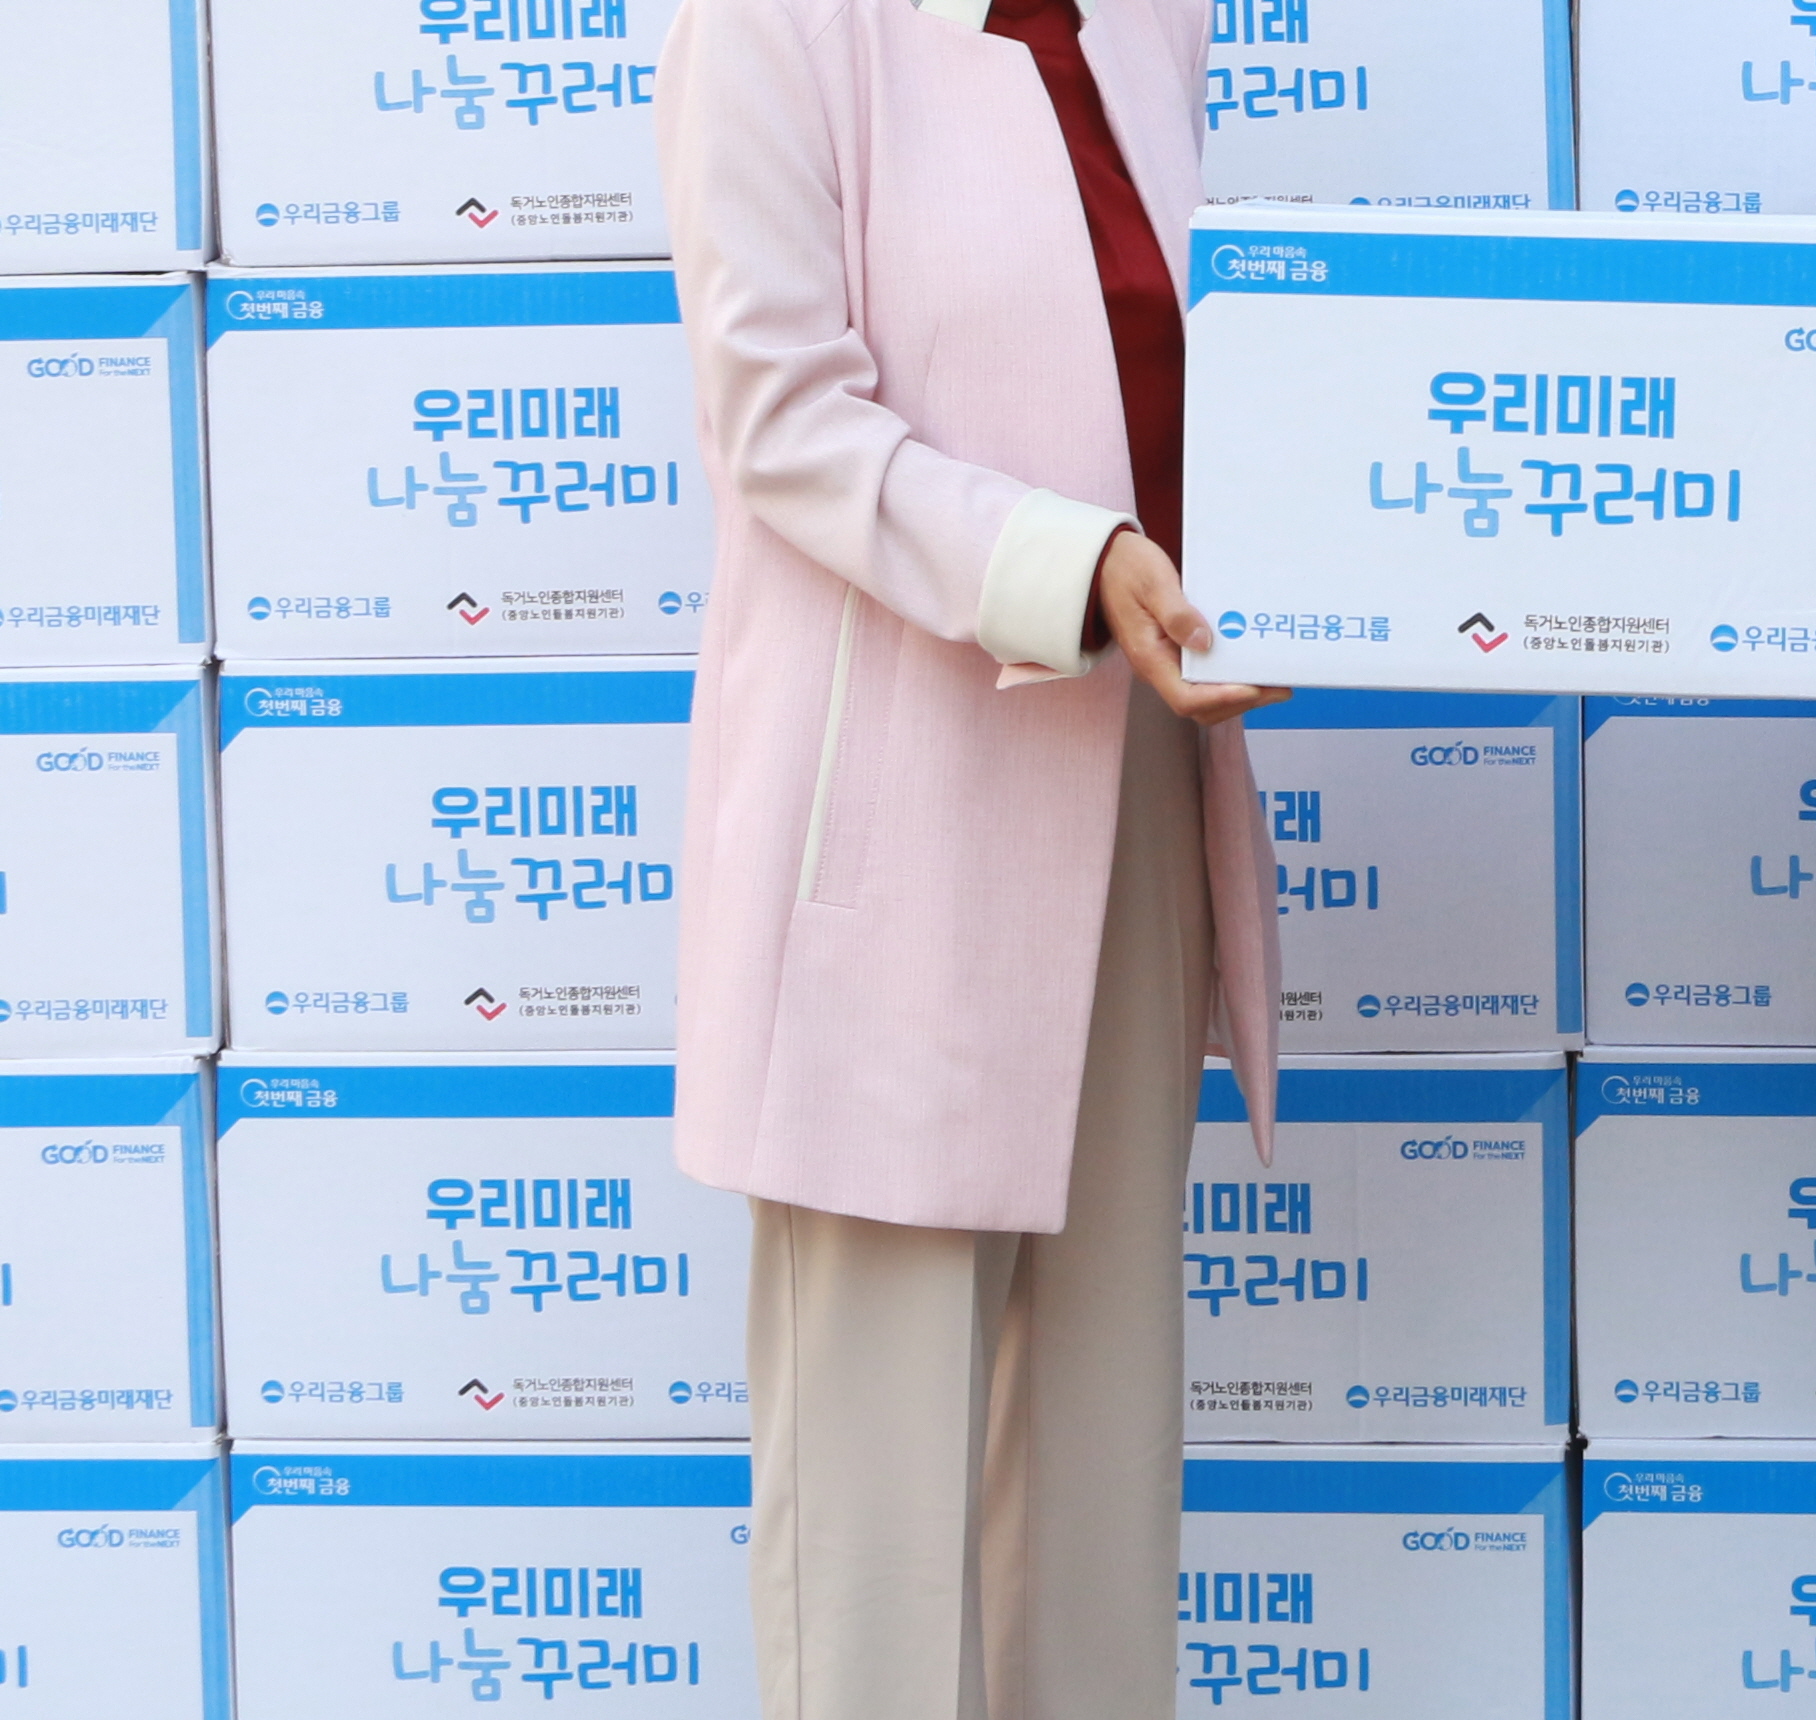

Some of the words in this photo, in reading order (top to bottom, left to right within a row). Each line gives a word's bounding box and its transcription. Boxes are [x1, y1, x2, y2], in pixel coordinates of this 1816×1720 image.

[5, 212, 158, 235] 우리금융미래재단
[284, 202, 400, 225] 우리금융그룹
[1228, 258, 1286, 281] 첫번째
[1290, 260, 1328, 282] 금융
[27, 353, 94, 378] GOOD
[98, 356, 151, 367] FINANCE
[413, 386, 621, 442] 우리미래
[1429, 372, 1675, 439] 우리미래
[275, 597, 391, 619] 우리금융그룹
[502, 589, 623, 605] 독거노인종합지원센터
[7, 605, 160, 628] 우리금융미래재단
[1251, 613, 1391, 641] 우리금융그룹
[1525, 615, 1669, 634] 독거노인종합지원센터
[37, 748, 103, 773] GOOD
[1411, 742, 1479, 766] GOOD
[1483, 745, 1537, 756] FINANCE
[431, 785, 638, 839] 우리미래
[293, 992, 409, 1014] 우리금융그룹
[1384, 994, 1539, 1016] 우리금융미래재단
[1653, 984, 1771, 1007] 우리금융그룹
[16, 998, 168, 1020] 우리금융미래재단
[255, 1089, 303, 1108] 첫번째
[306, 1089, 338, 1108] 금융
[1616, 1086, 1665, 1105] 첫번째
[1669, 1086, 1701, 1105] 금융
[1401, 1136, 1468, 1160] GOOD
[1473, 1140, 1526, 1151] FINANCE
[427, 1178, 632, 1230] 우리미래
[21, 1389, 173, 1410] 우리금융미래재단
[288, 1381, 404, 1403] 우리금융그룹
[1191, 1381, 1312, 1396] 독거노인종합지원센터
[1374, 1386, 1527, 1407] 우리금융미래재단
[1643, 1381, 1760, 1403] 우리금융그룹
[1403, 1527, 1470, 1551] GOOD
[1474, 1532, 1527, 1542] FINANCE
[439, 1567, 643, 1619] 우리미래
